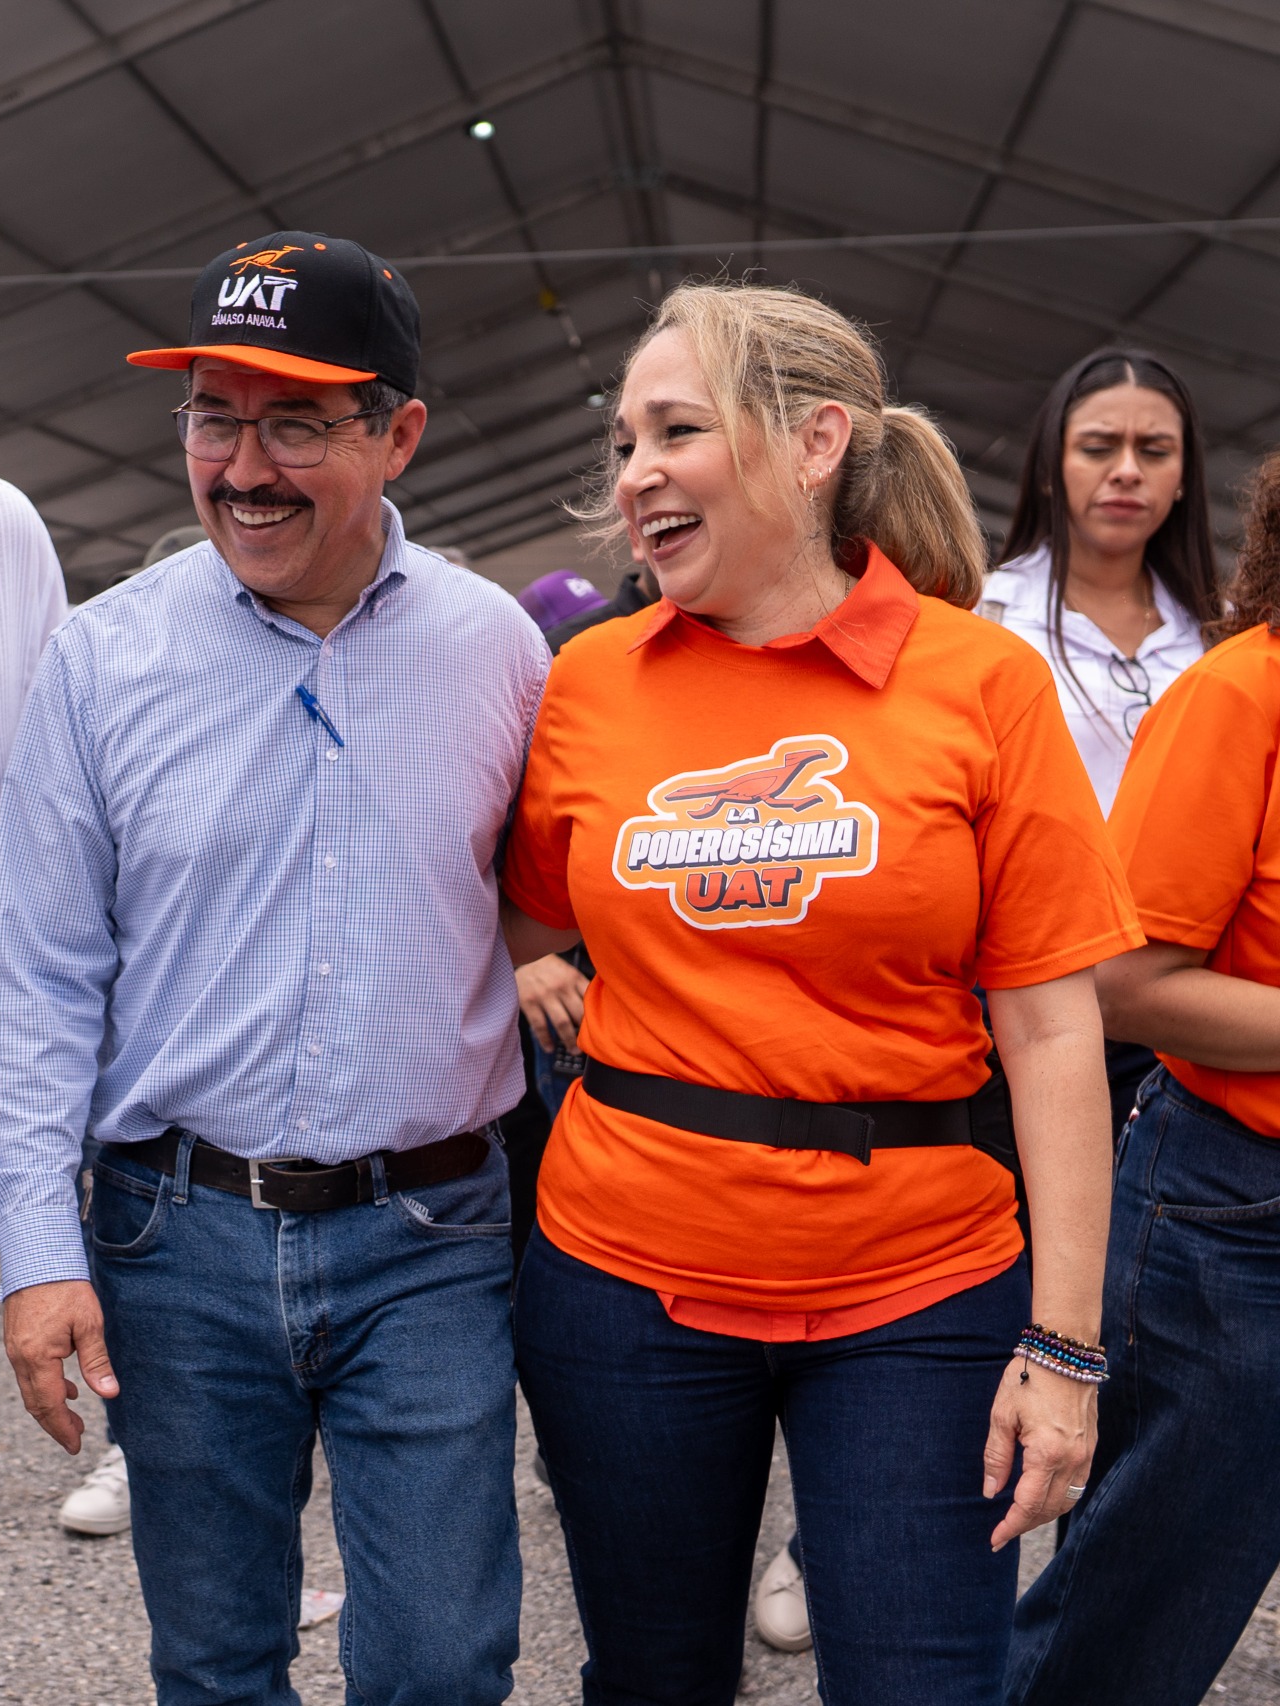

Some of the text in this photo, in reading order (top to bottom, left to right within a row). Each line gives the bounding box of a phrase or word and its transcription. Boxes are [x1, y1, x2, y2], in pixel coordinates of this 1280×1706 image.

[217, 273, 299, 311] UAT
[726, 807, 759, 823] LA
[627, 818, 858, 871] PODEROSÍSIMA
[686, 867, 802, 911] UAT
